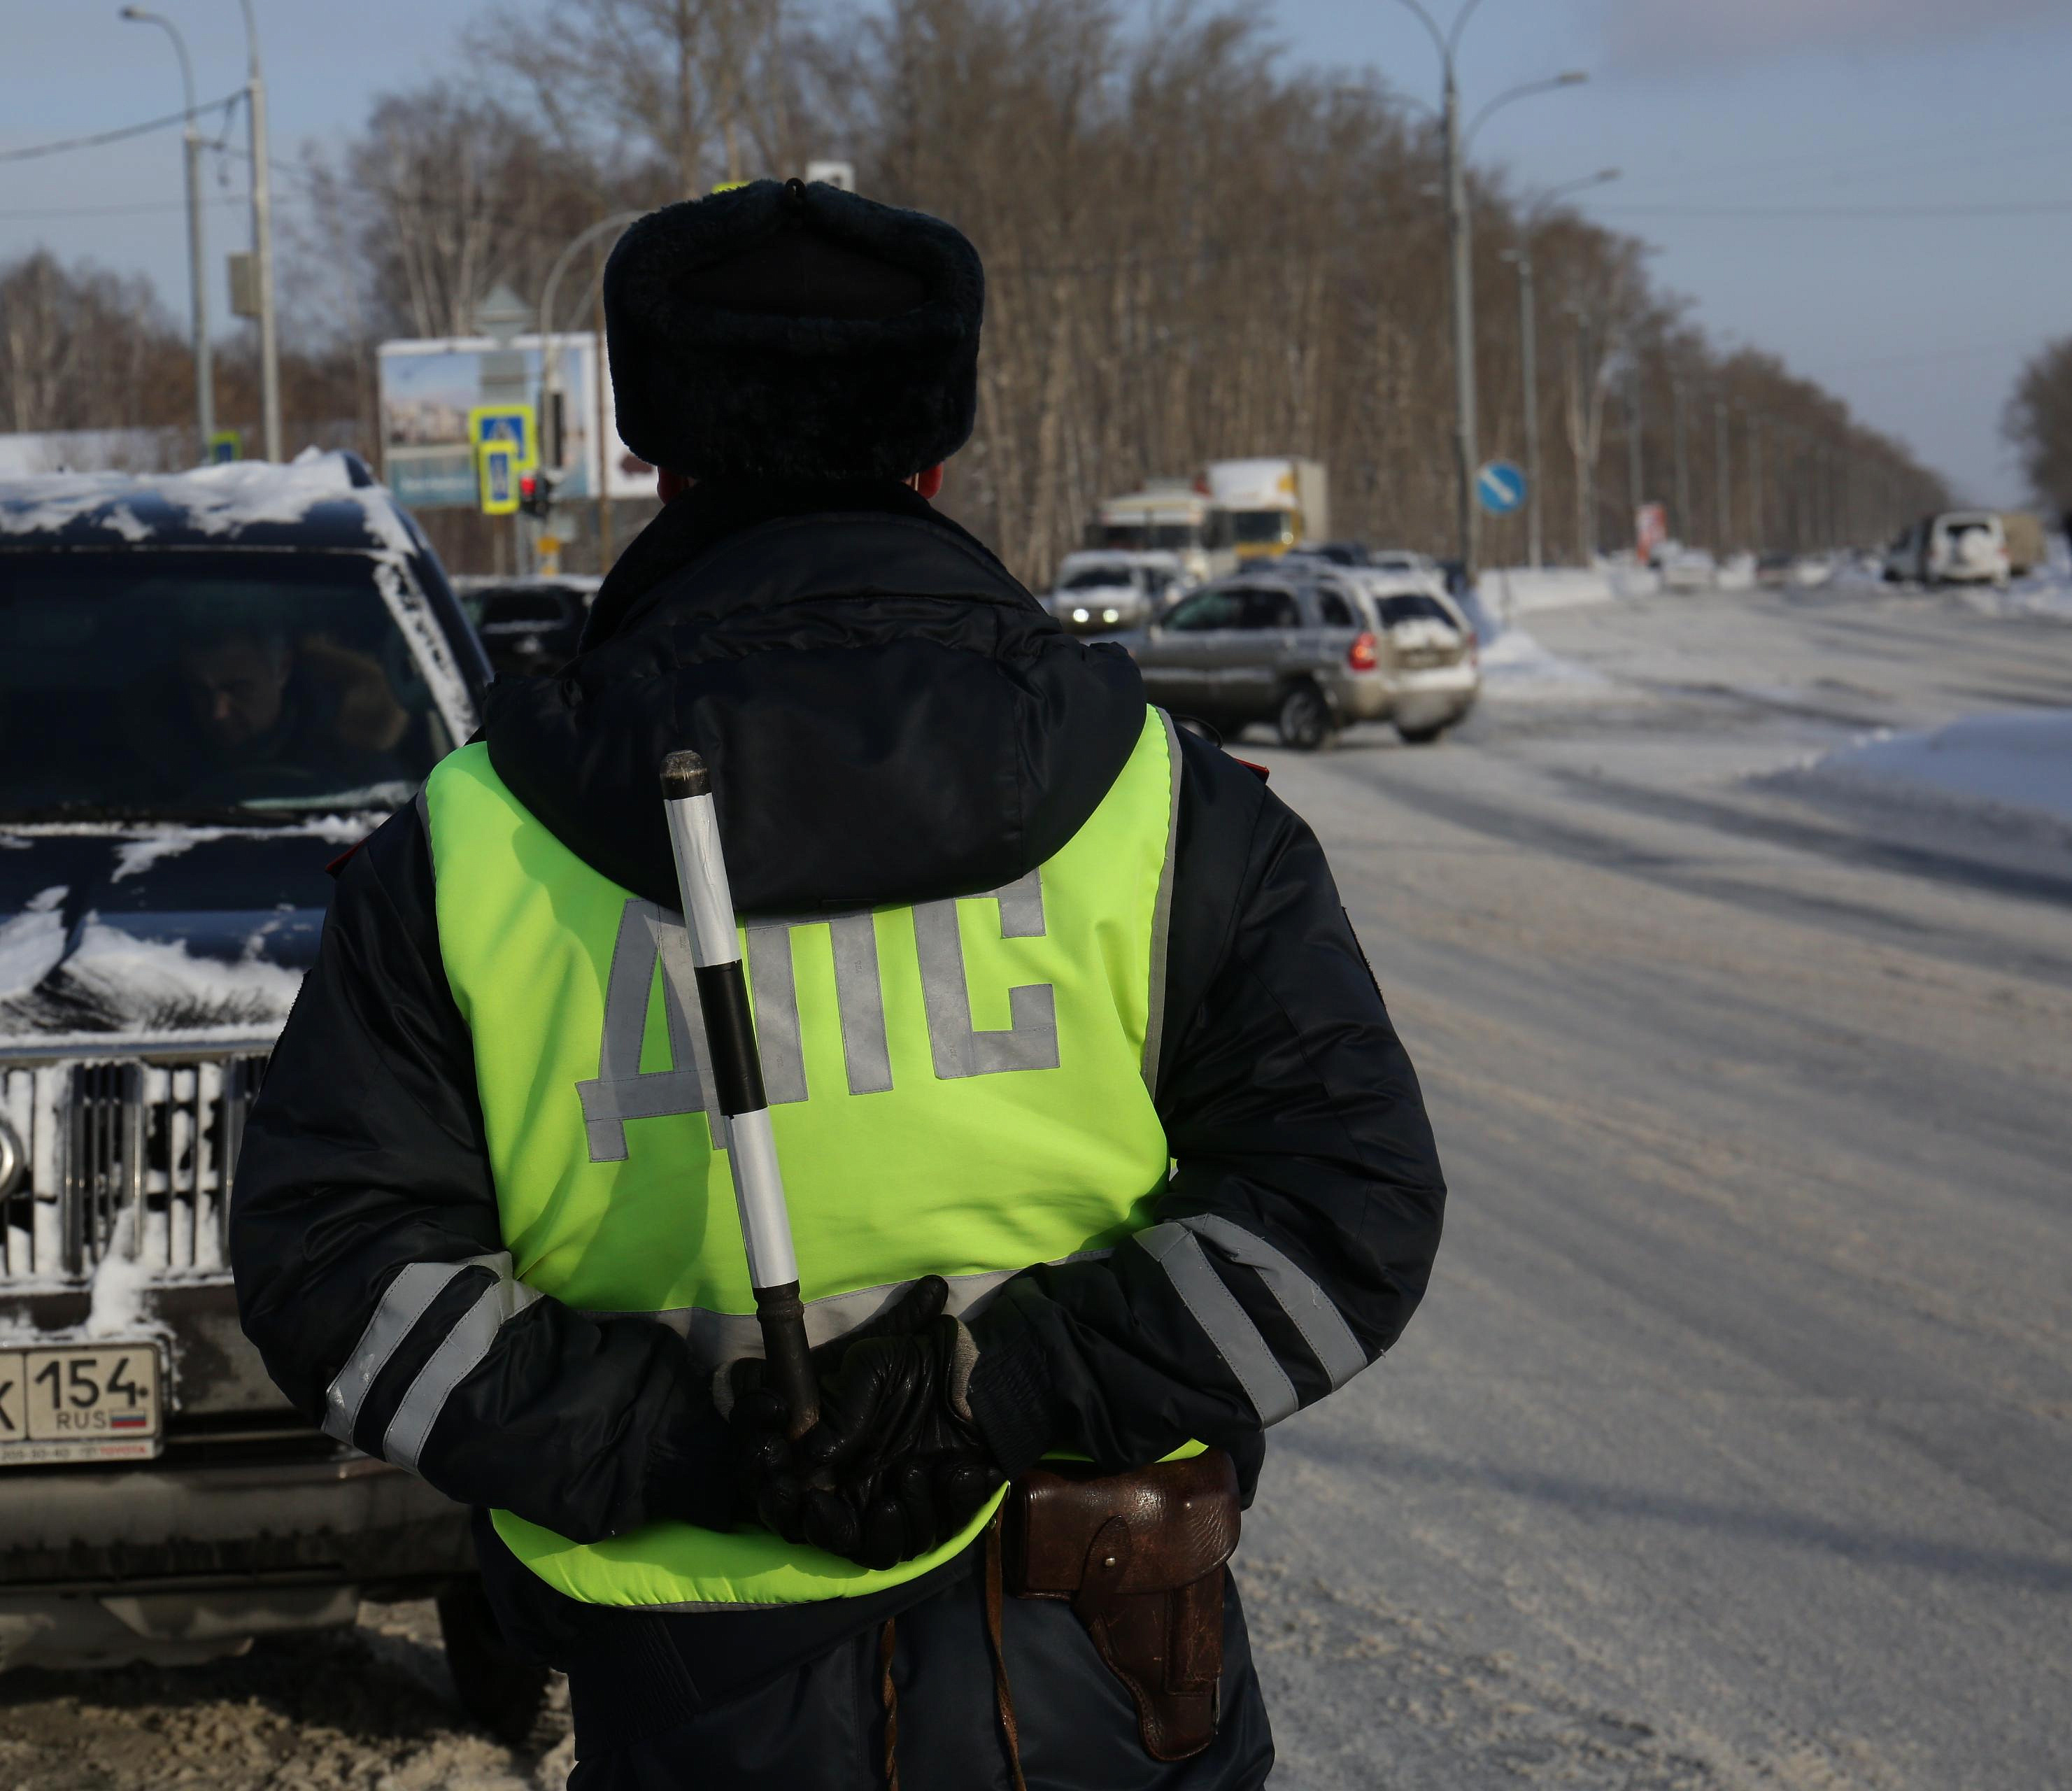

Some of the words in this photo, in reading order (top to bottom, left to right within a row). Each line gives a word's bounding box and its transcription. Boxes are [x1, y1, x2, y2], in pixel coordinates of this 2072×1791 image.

[576, 868, 1059, 1163] ДПС
[35, 1357, 136, 1409] 154
[57, 1411, 106, 1429] RUS
